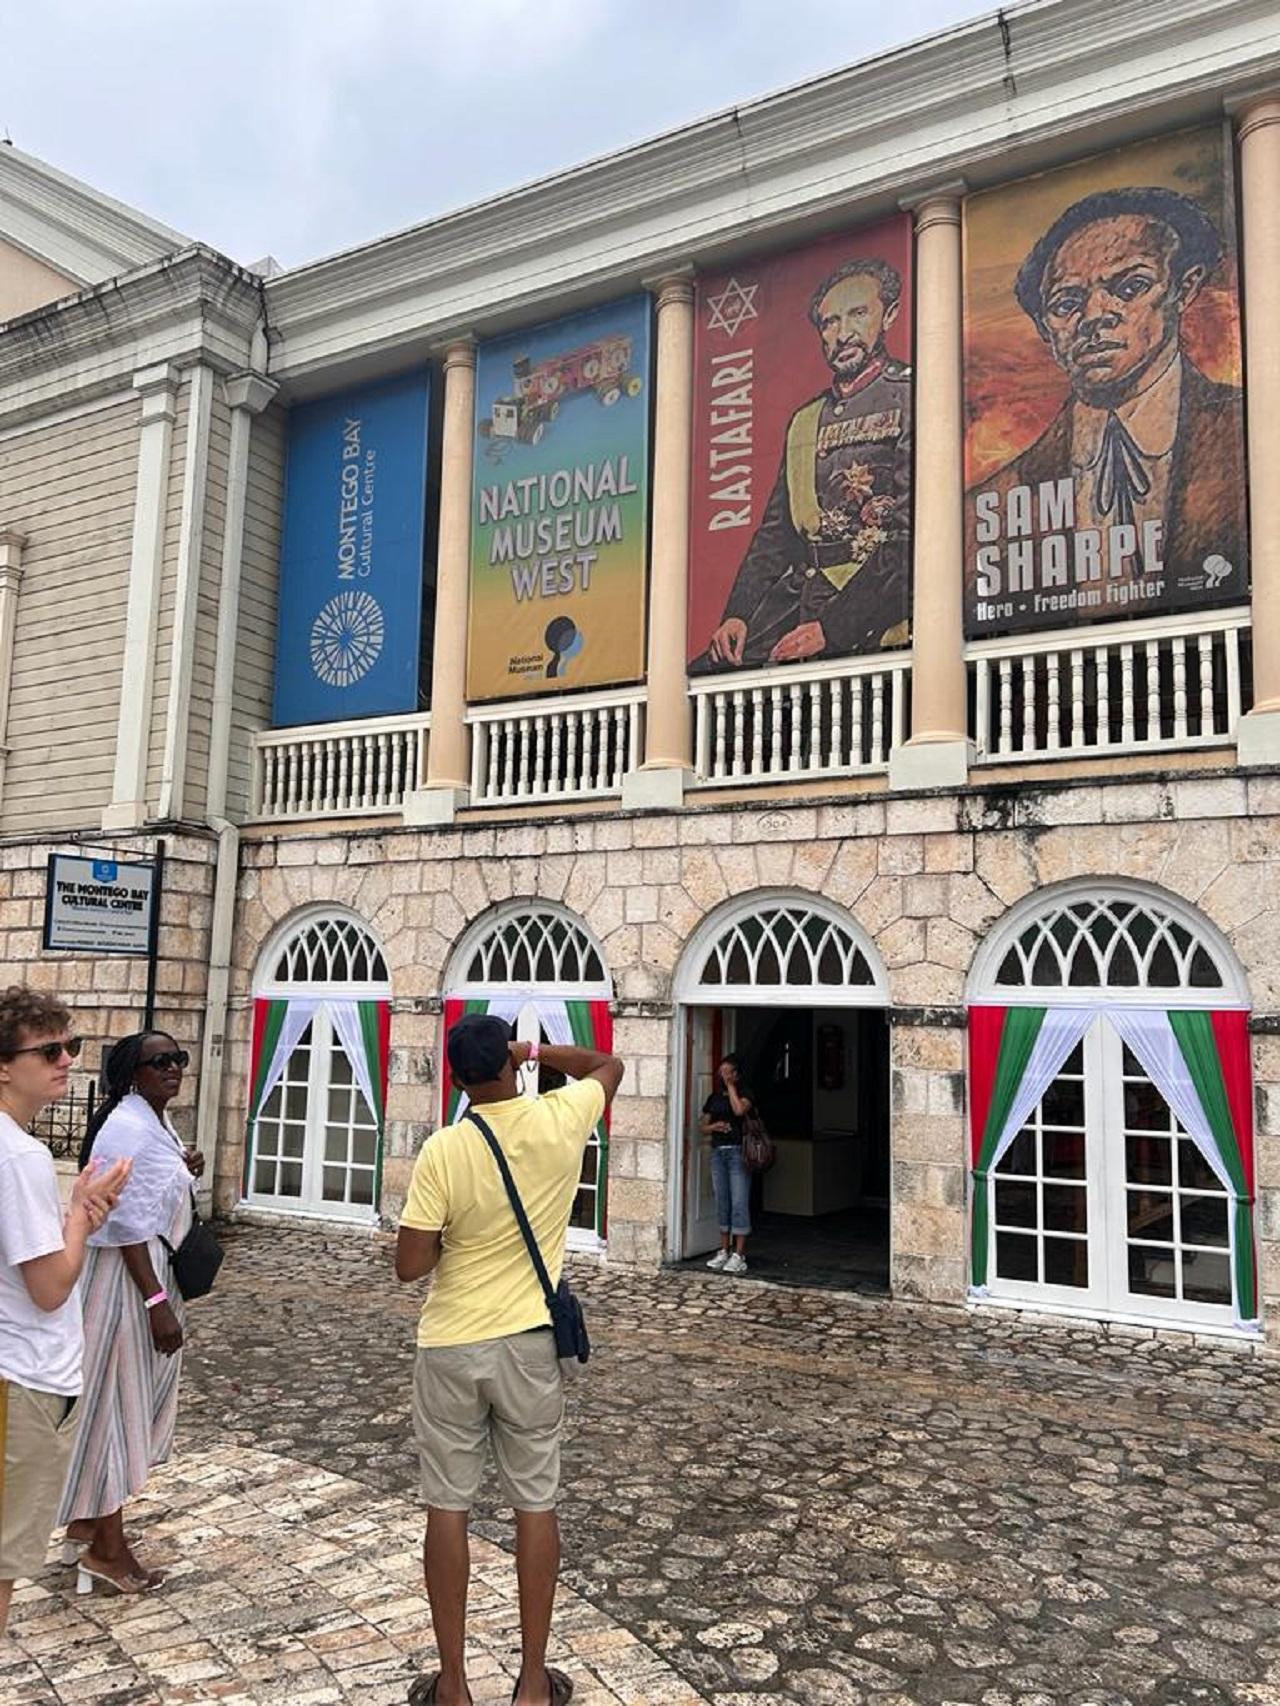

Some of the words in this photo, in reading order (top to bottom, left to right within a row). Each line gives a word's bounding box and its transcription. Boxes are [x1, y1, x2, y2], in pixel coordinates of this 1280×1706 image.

[343, 418, 362, 461] BAY
[709, 348, 753, 531] RASTAFARI
[362, 449, 376, 509] Centre
[479, 455, 637, 524] NATIONAL
[338, 464, 359, 580] MONTEGO
[490, 504, 622, 564] MUSEUM
[976, 477, 1075, 542] SAM
[358, 510, 373, 577] Cultural
[976, 519, 1164, 597] SHARPE
[512, 552, 597, 601] WEST
[977, 602, 1013, 621] Hero
[1034, 588, 1101, 613] Freedom
[57, 881, 75, 893] THE
[78, 884, 129, 898] MONTEGO
[131, 889, 149, 900] BAY
[61, 895, 108, 907] CULTURAL
[110, 899, 143, 911] CENTRE
